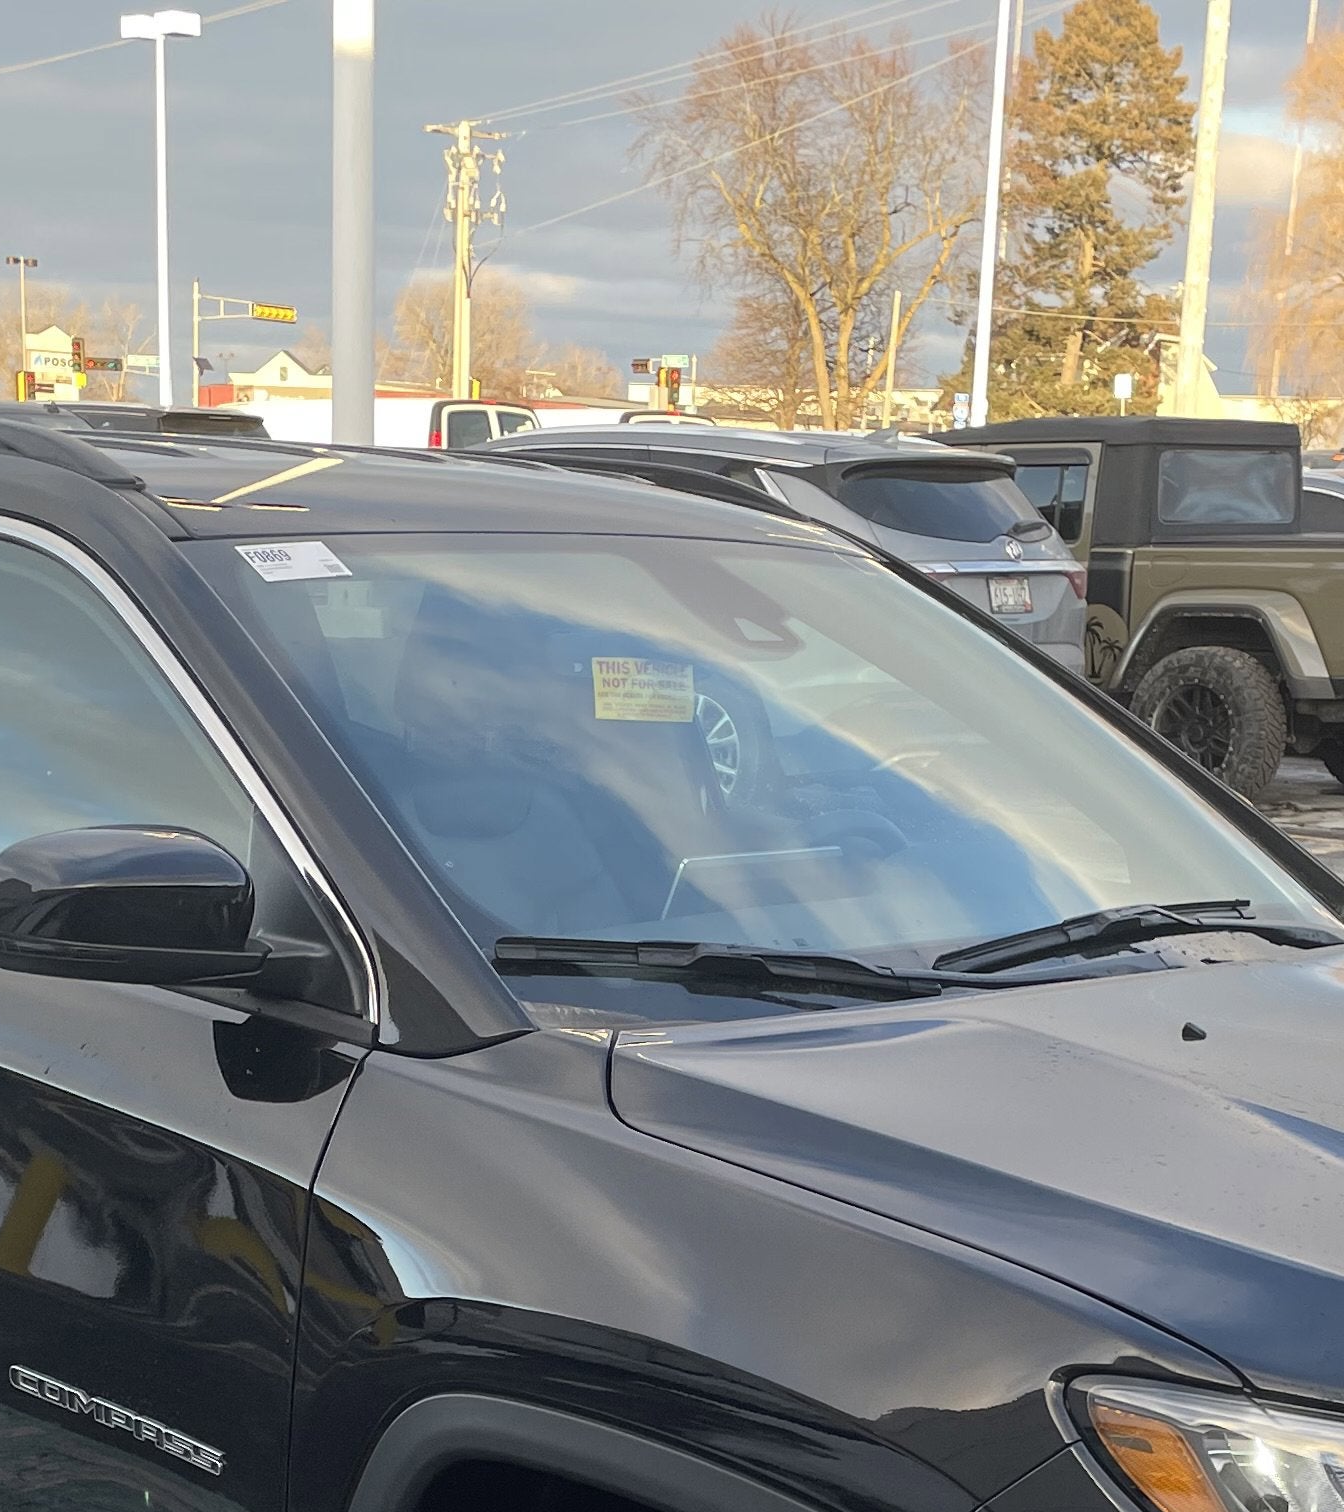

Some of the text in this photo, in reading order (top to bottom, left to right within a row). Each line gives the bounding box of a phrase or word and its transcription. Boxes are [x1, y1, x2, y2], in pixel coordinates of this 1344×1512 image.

[244, 549, 292, 564] F0869
[596, 661, 631, 675] THIS
[602, 677, 628, 688] NOT
[631, 679, 654, 689] FOR
[9, 1364, 227, 1476] COMPASS
